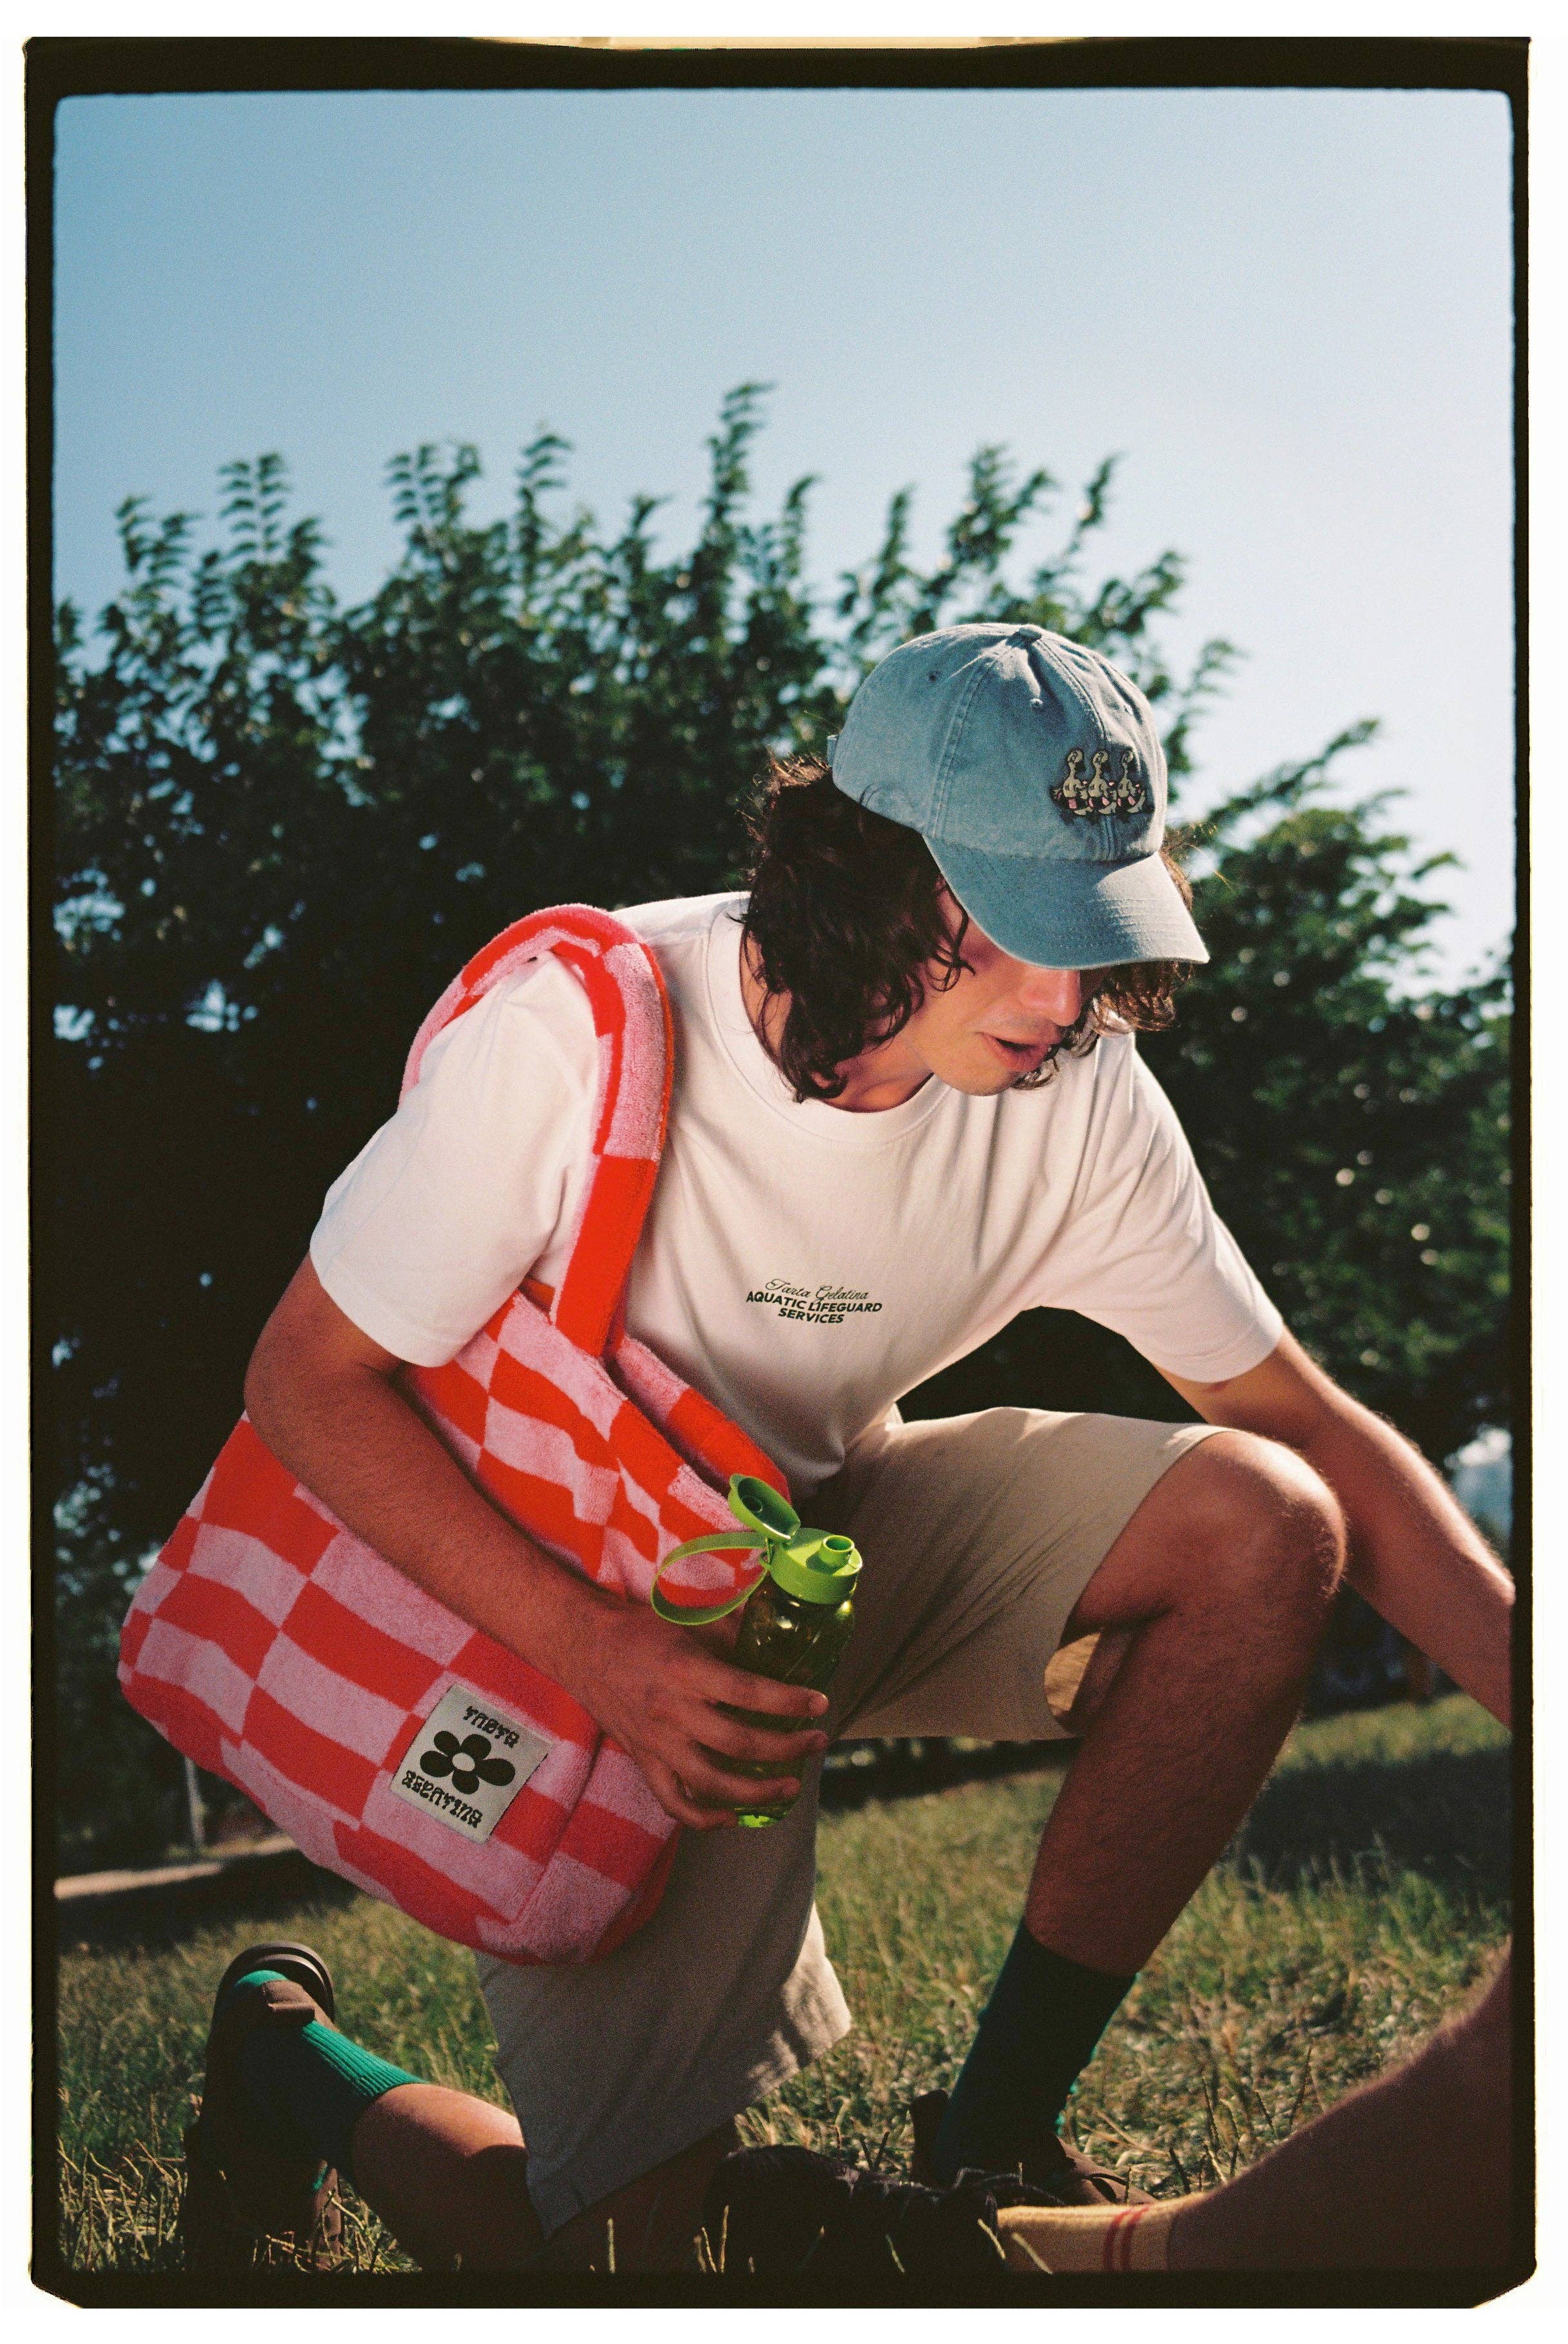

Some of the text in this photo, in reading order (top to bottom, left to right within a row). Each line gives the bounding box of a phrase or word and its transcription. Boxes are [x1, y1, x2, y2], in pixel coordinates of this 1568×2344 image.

[746, 1291, 883, 1313] AQUATIC LIFEGUARD
[765, 1278, 869, 1304] Tarta Gelatina
[778, 1308, 846, 1324] SERVICES
